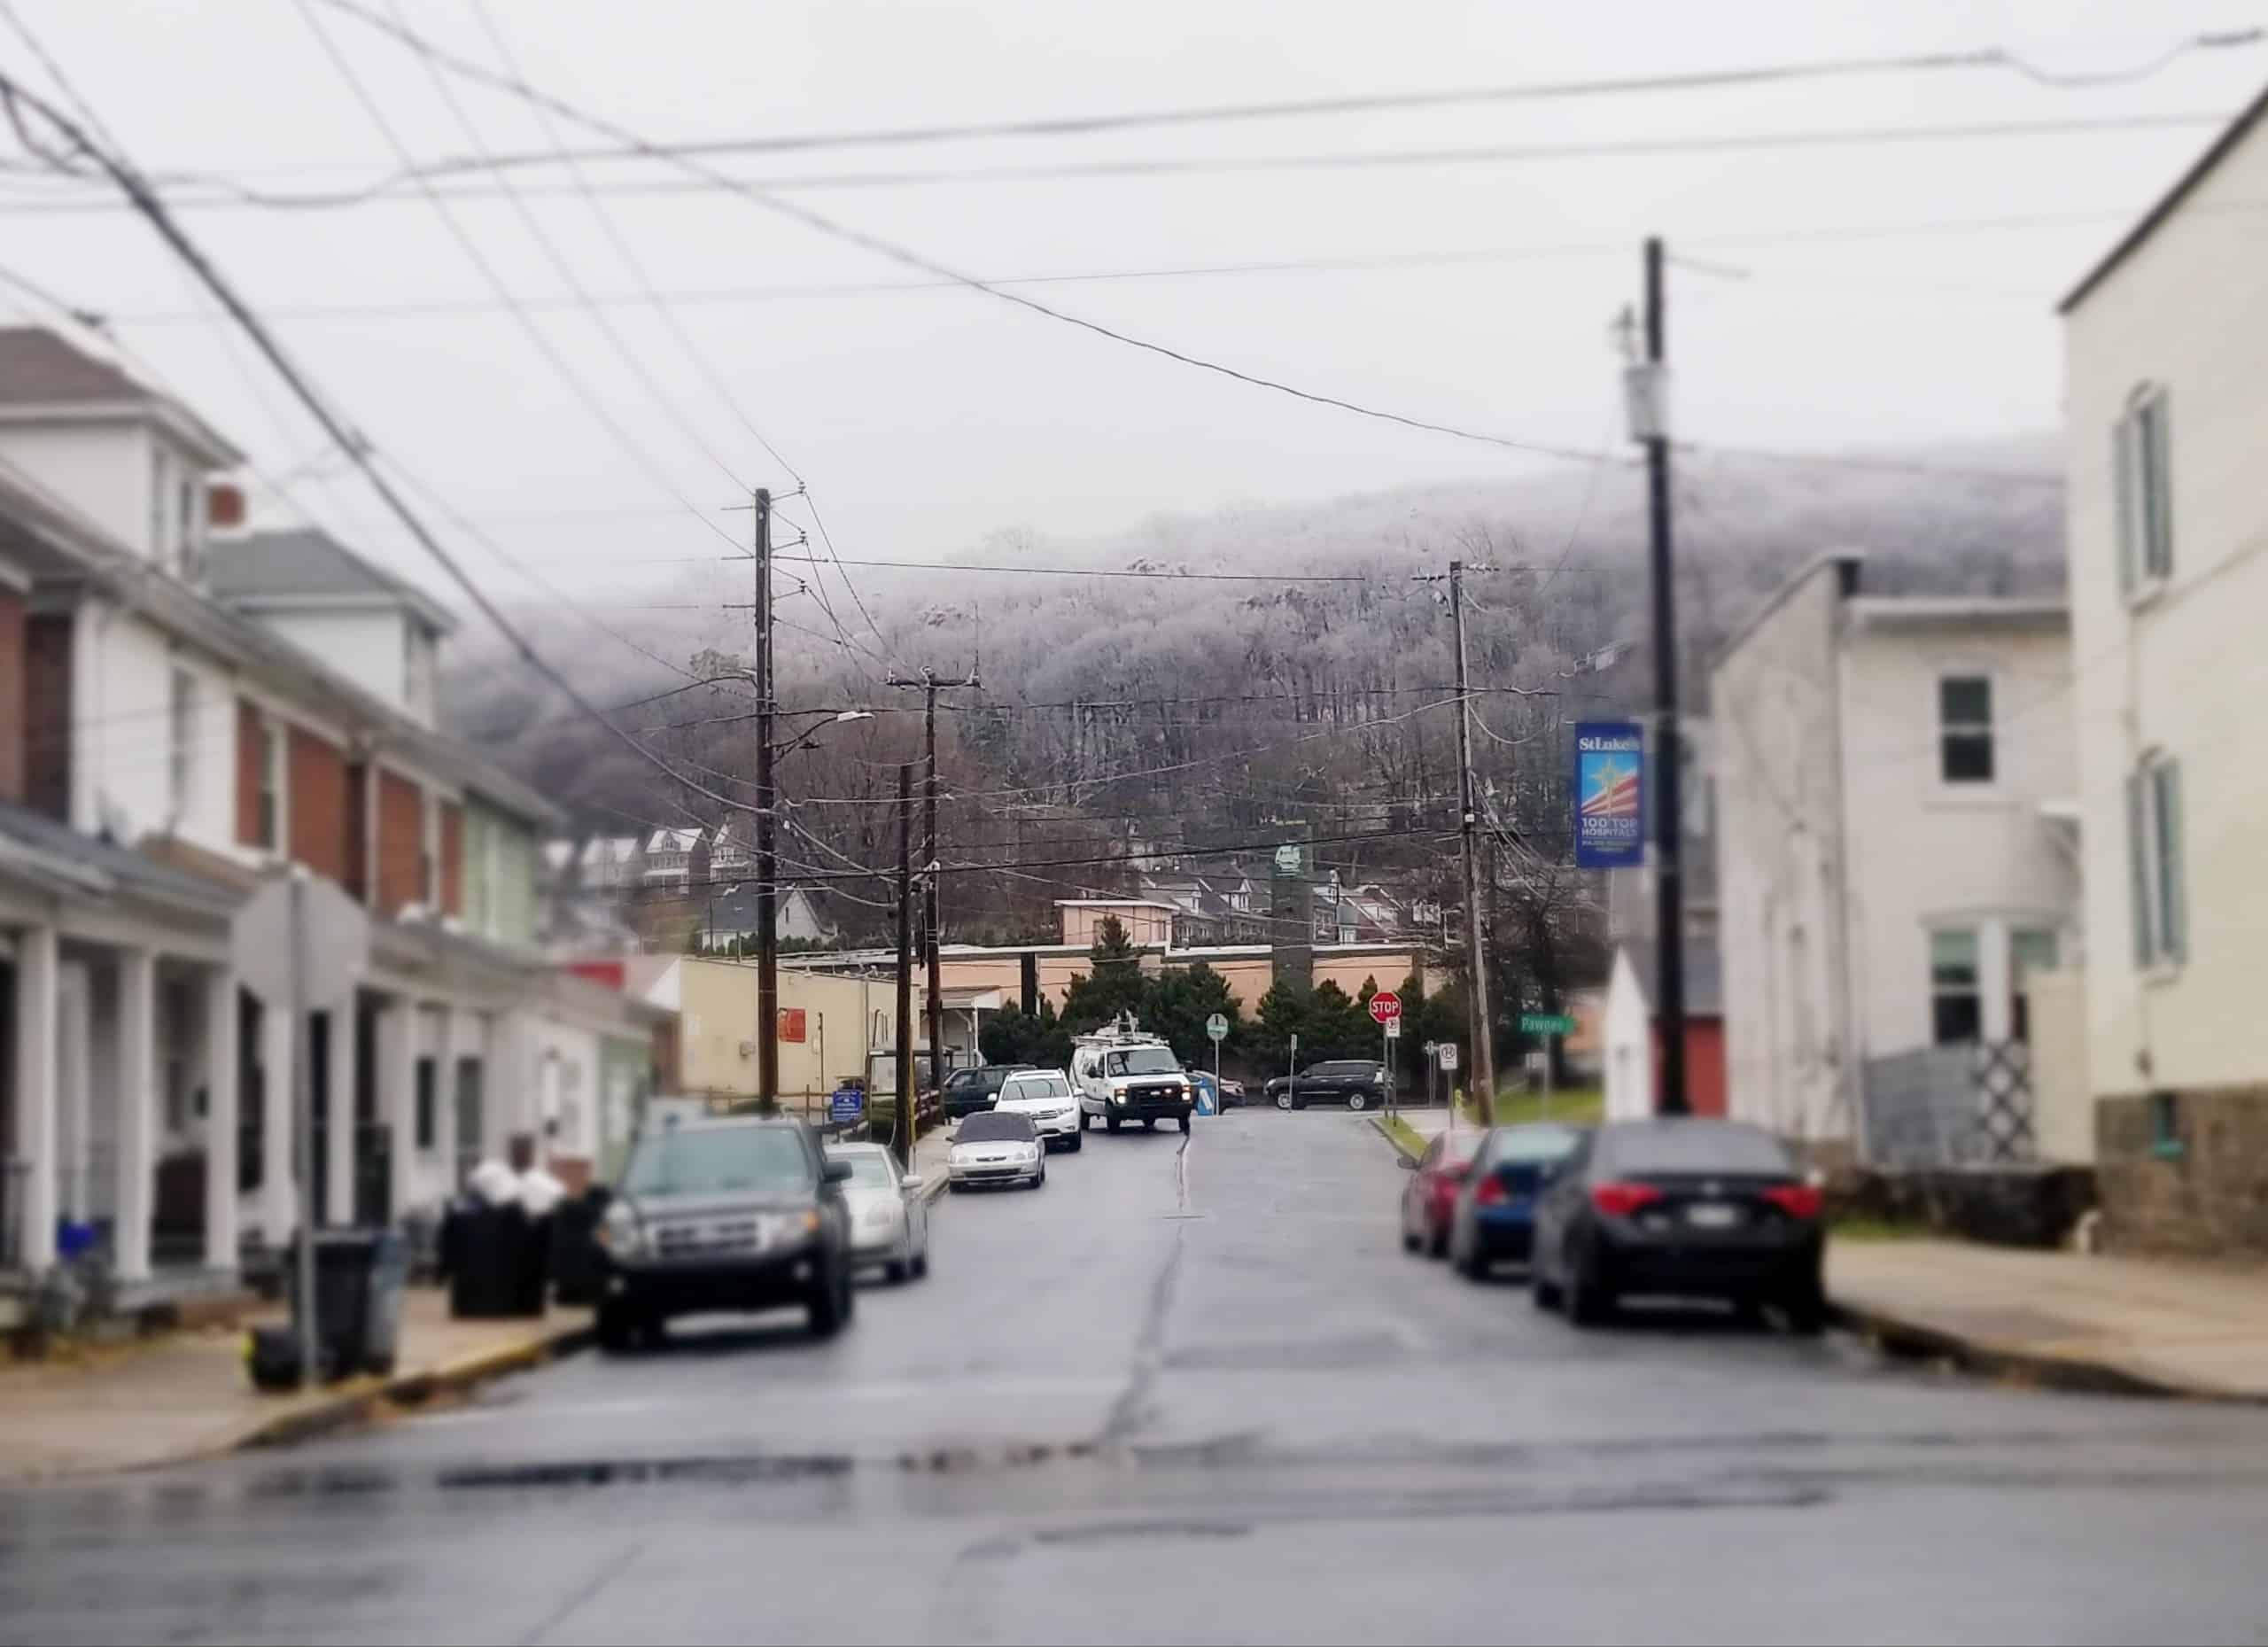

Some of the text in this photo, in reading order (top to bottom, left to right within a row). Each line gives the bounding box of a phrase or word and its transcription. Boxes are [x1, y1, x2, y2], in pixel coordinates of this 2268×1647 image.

[1581, 818, 1637, 829] 100 TOP
[1581, 828, 1637, 837] HOSPITALS
[1372, 1001, 1399, 1014] STOP
